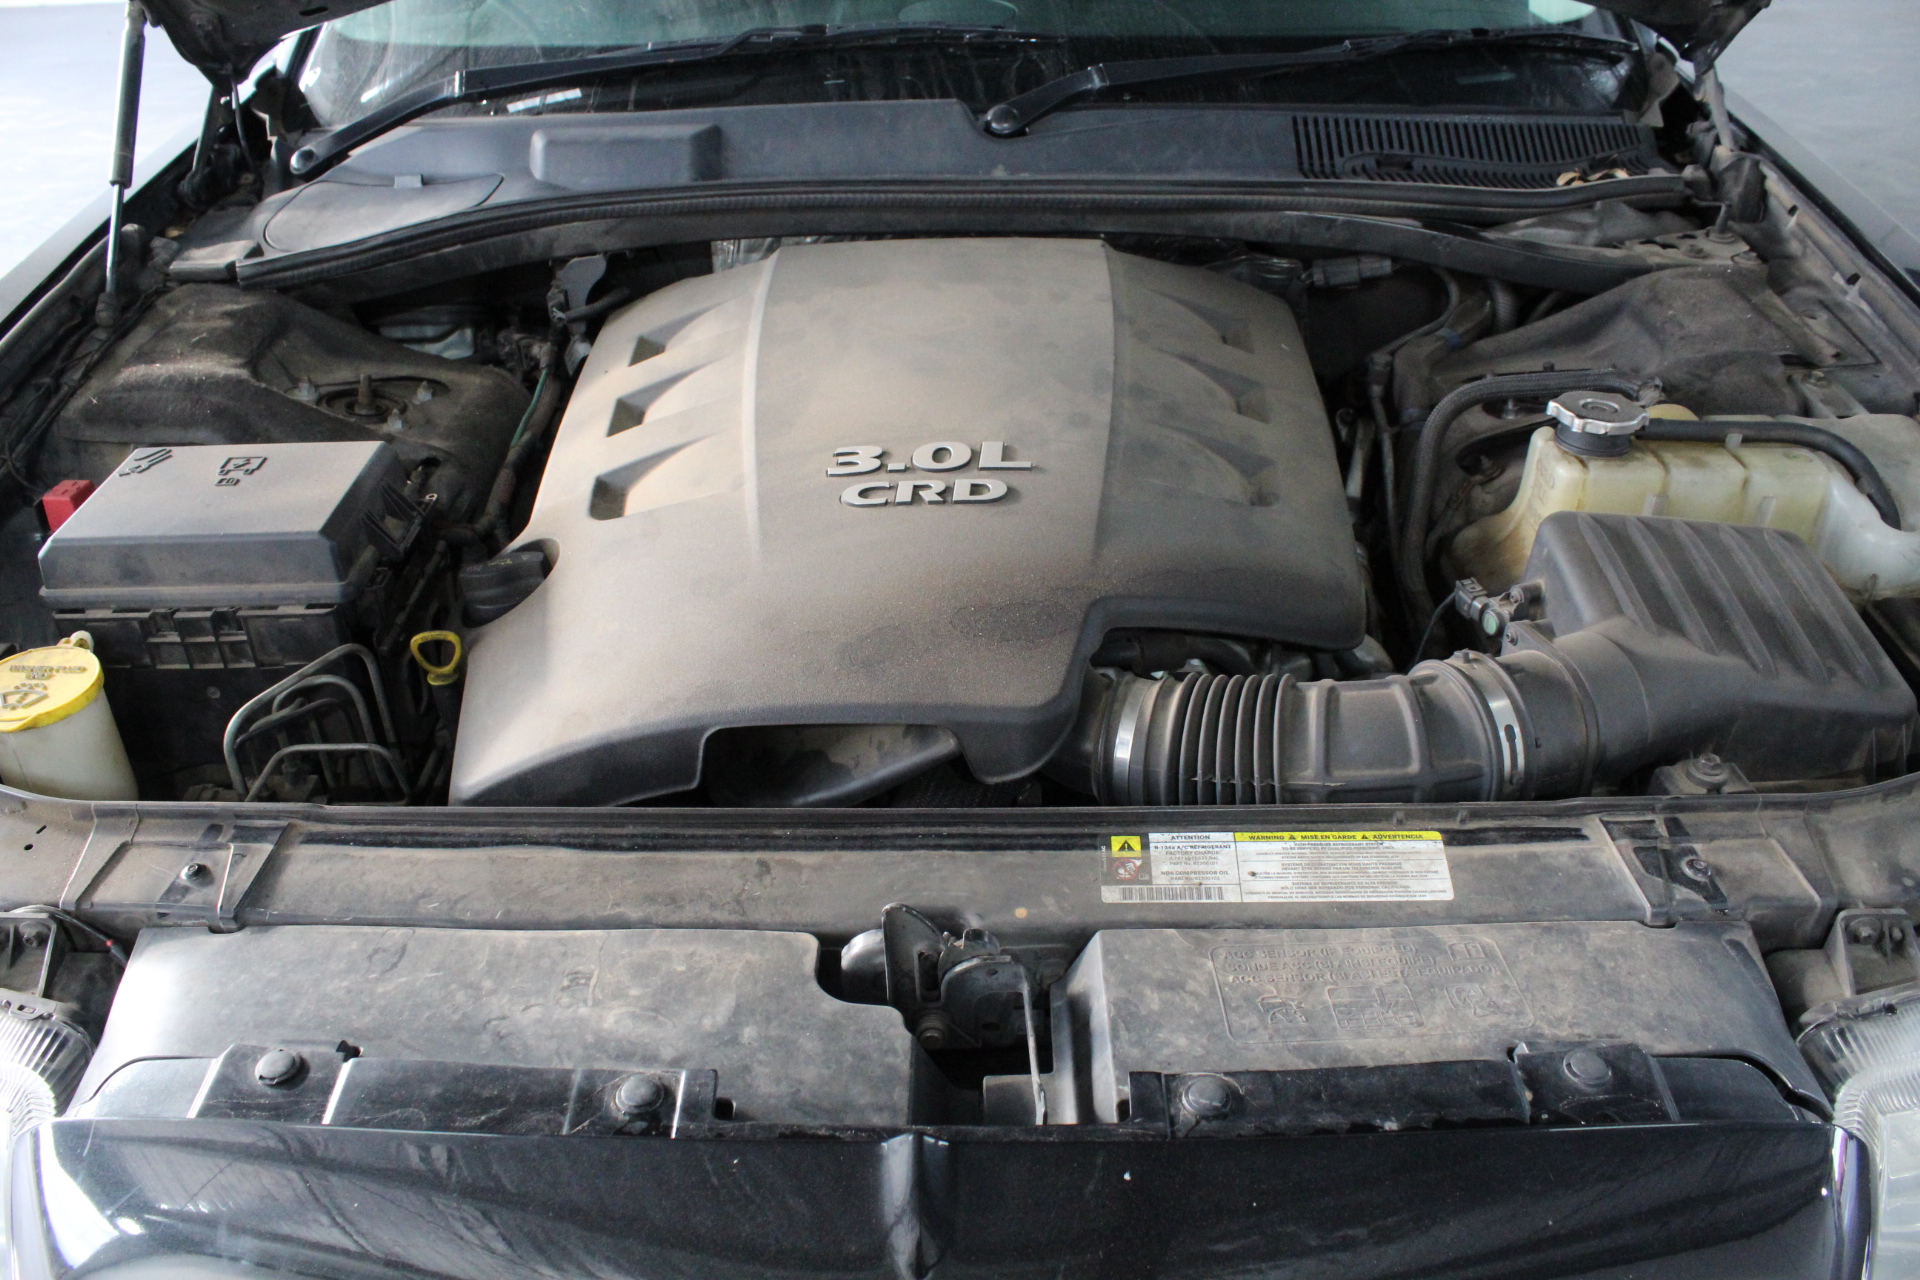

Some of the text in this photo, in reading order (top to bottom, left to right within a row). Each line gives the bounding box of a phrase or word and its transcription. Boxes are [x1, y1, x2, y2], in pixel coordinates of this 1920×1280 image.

[826, 441, 1032, 477] 3.0L
[839, 478, 1008, 508] CRD
[1256, 949, 1316, 959] SENSOR
[1318, 947, 1338, 958] (IF
[1338, 944, 1418, 956] EQUIPPED)
[1225, 962, 1279, 972] SONDE
[1280, 961, 1312, 970] ACC
[1228, 974, 1262, 984] ACC
[1262, 972, 1326, 983] SENSOR
[1416, 964, 1498, 977] EQUIPADO)
